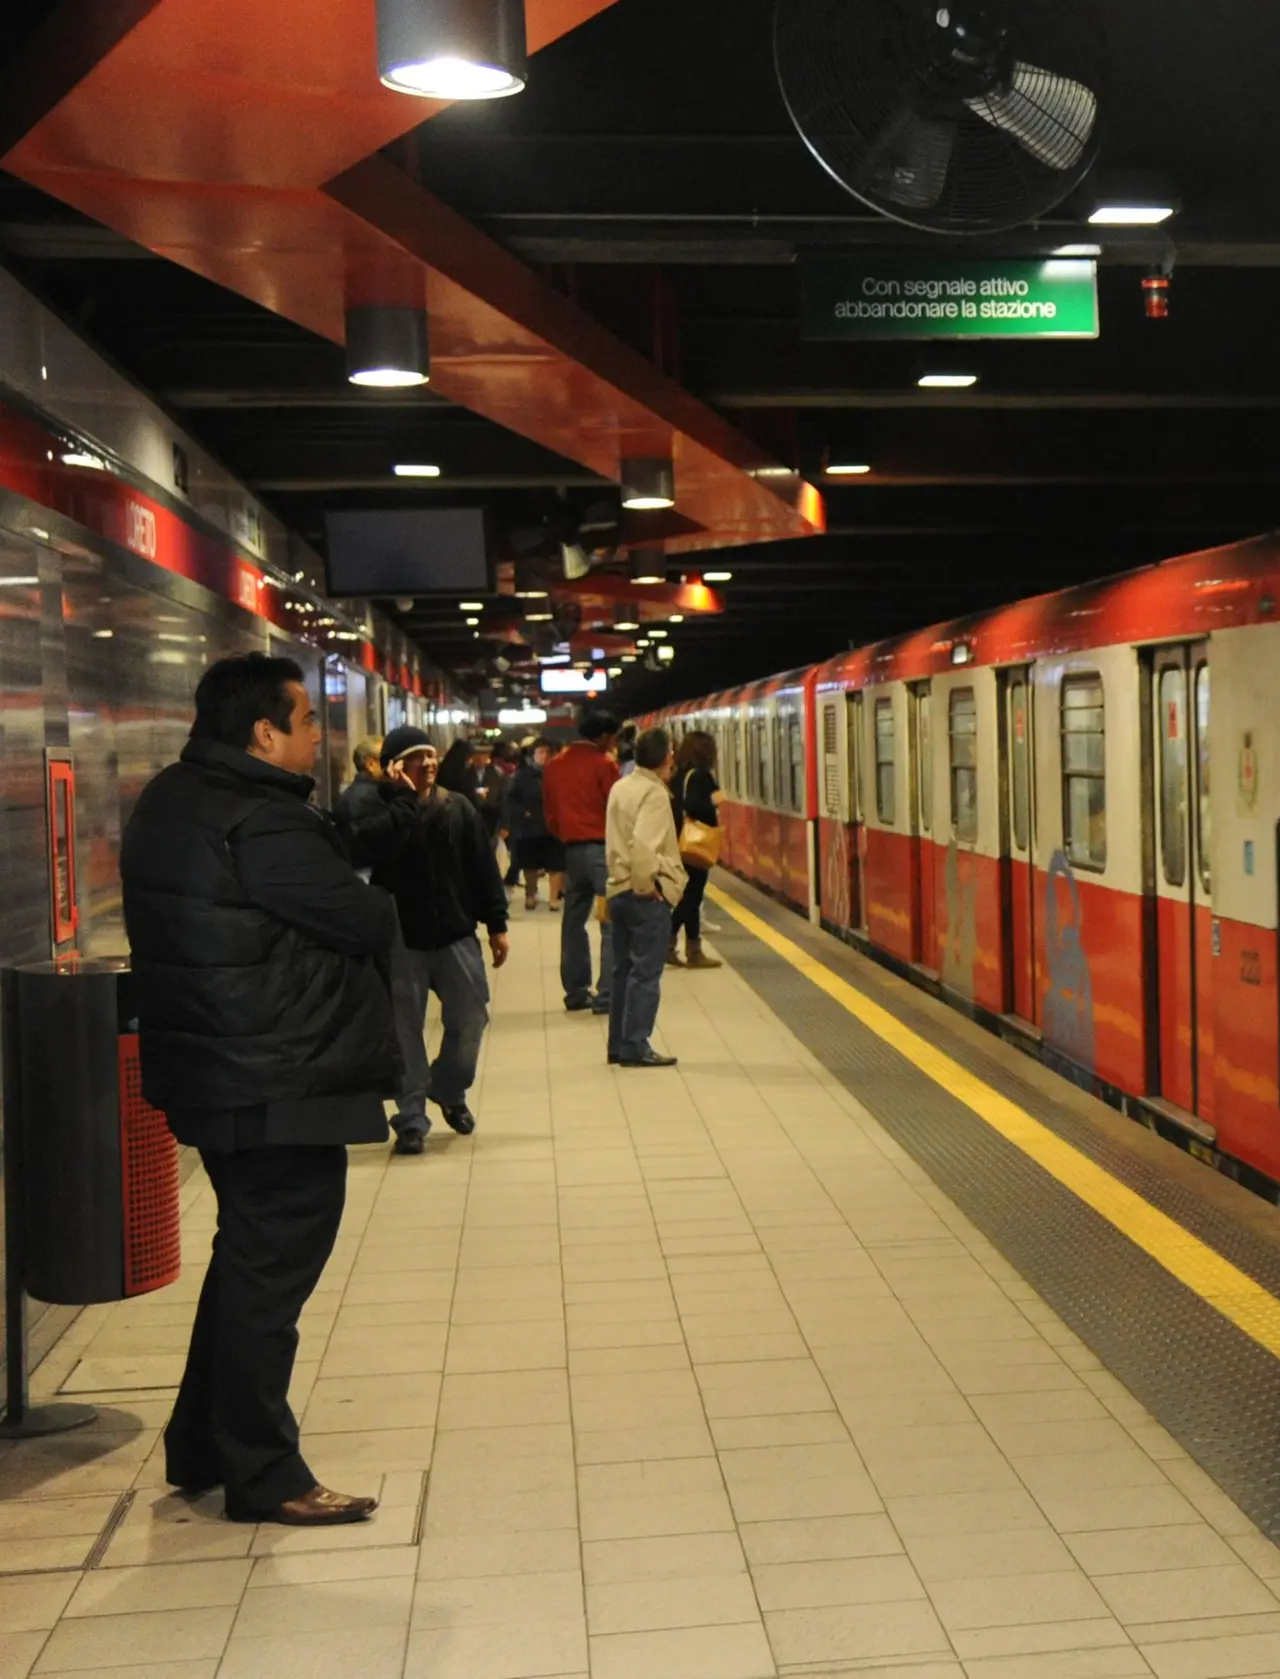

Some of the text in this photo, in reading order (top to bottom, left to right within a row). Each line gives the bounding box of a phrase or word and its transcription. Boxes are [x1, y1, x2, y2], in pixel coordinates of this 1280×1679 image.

[862, 276, 1029, 299] Con segnale attivo
[834, 300, 1057, 318] abbandonare la stazione
